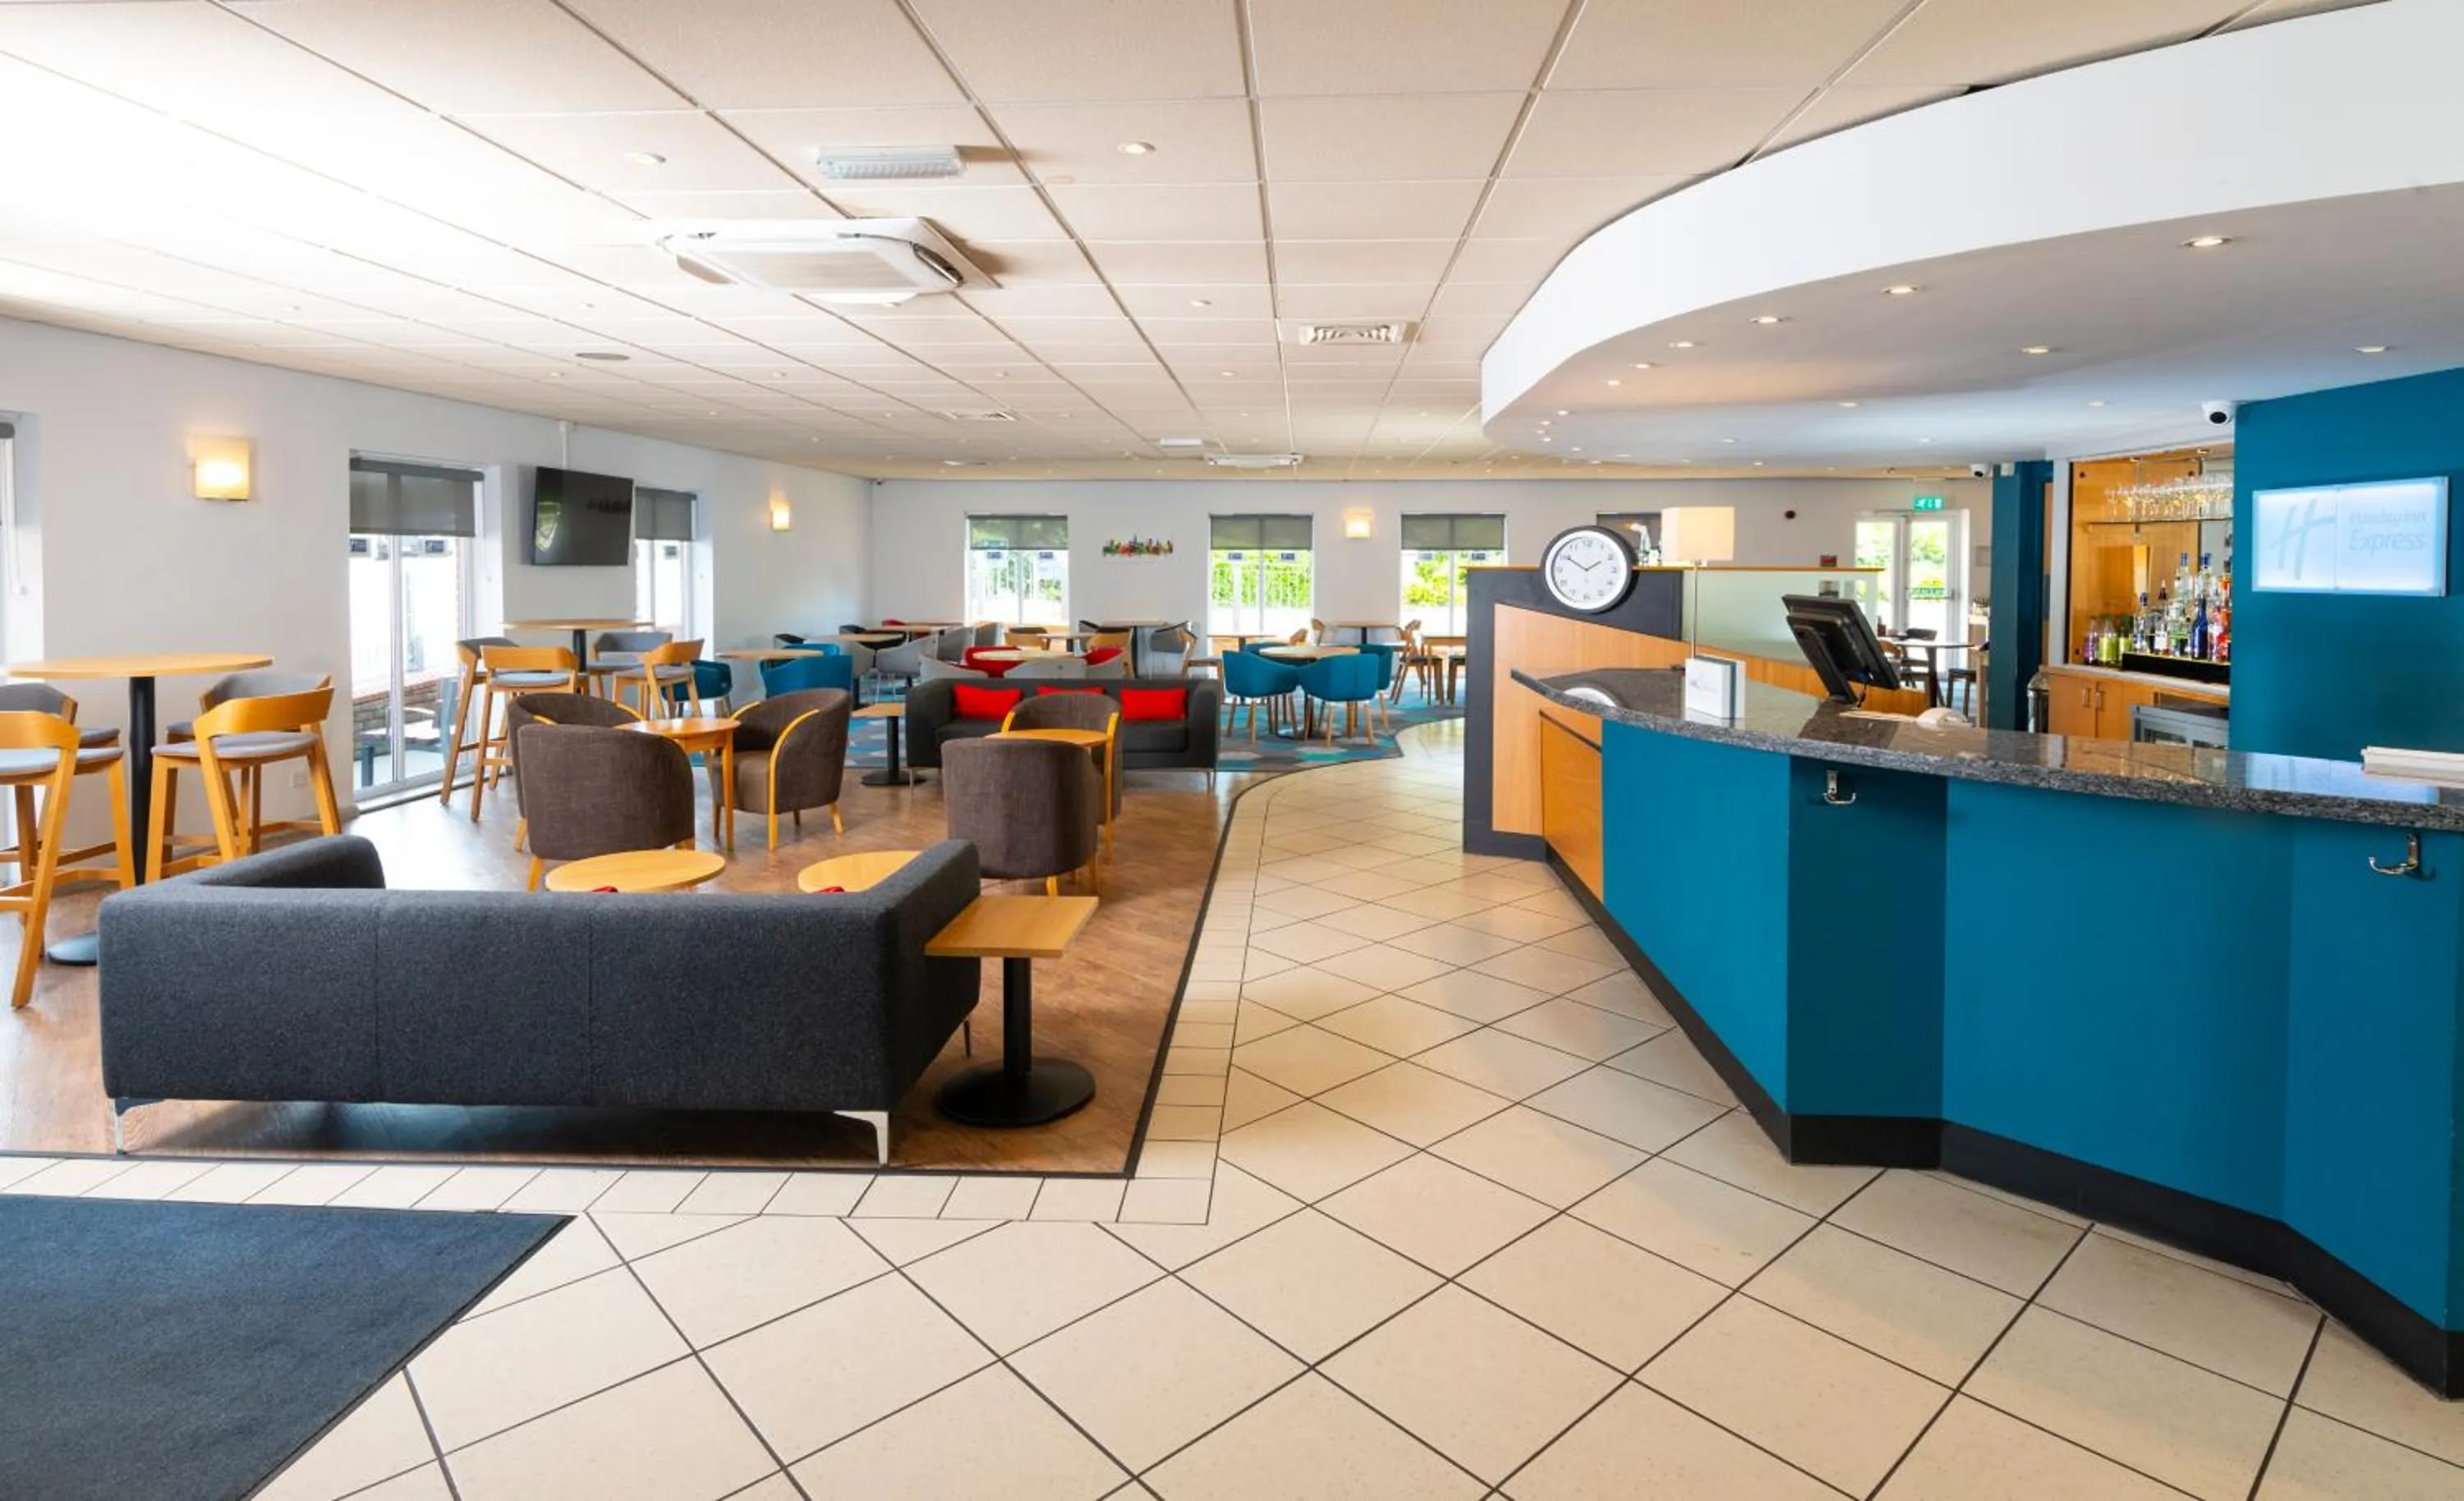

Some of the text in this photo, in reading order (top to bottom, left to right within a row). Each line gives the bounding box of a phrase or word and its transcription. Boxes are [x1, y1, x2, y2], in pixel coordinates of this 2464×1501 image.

[1569, 543, 1578, 552] 11
[1582, 539, 1593, 548] 12
[2349, 528, 2426, 558] Express
